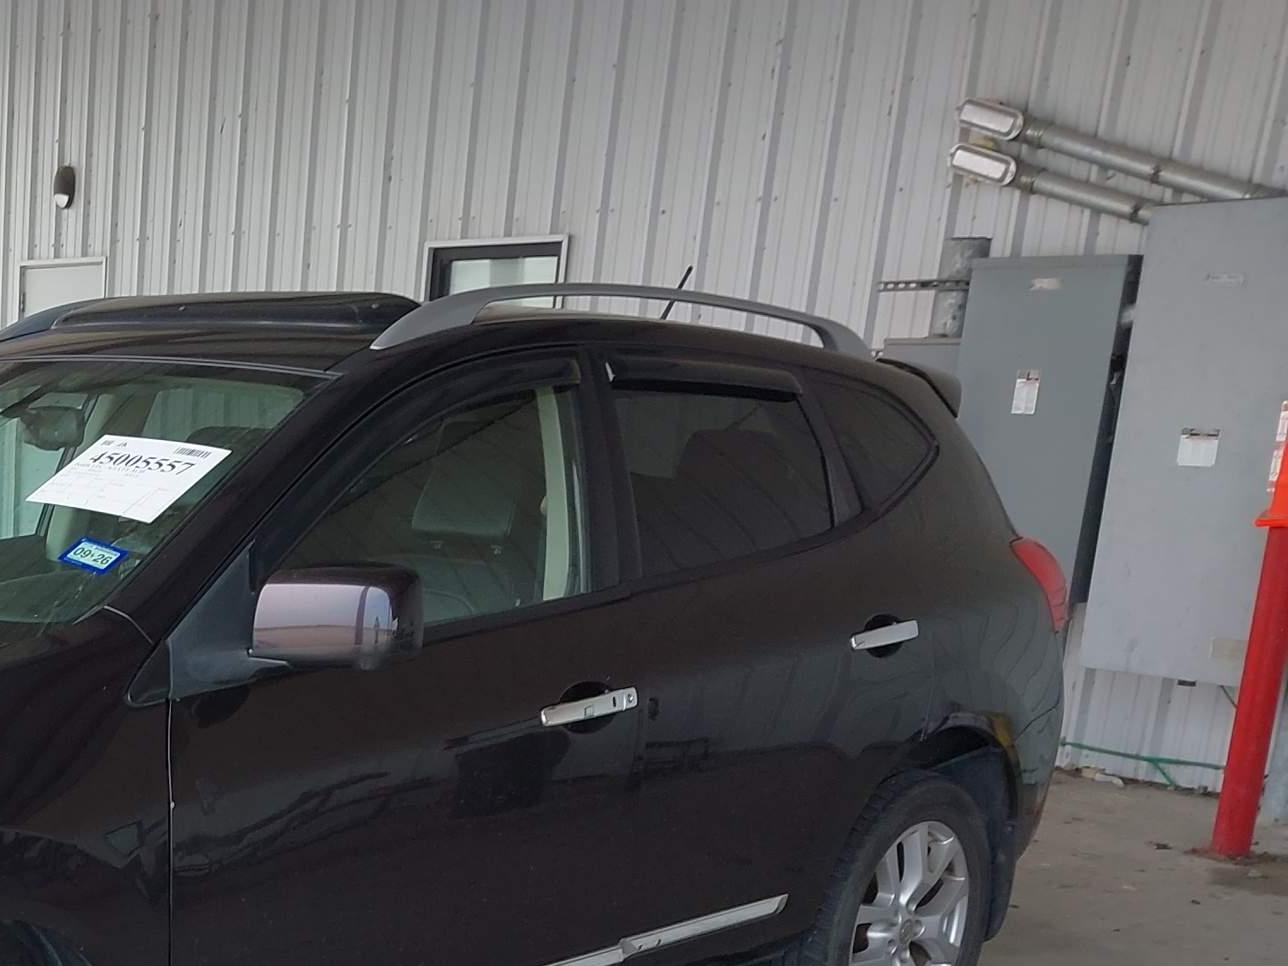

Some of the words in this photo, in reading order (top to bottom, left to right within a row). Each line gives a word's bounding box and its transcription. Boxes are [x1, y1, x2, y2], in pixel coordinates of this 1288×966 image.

[89, 450, 197, 476] 45005557
[73, 547, 92, 559] 09
[92, 553, 113, 565] 26
